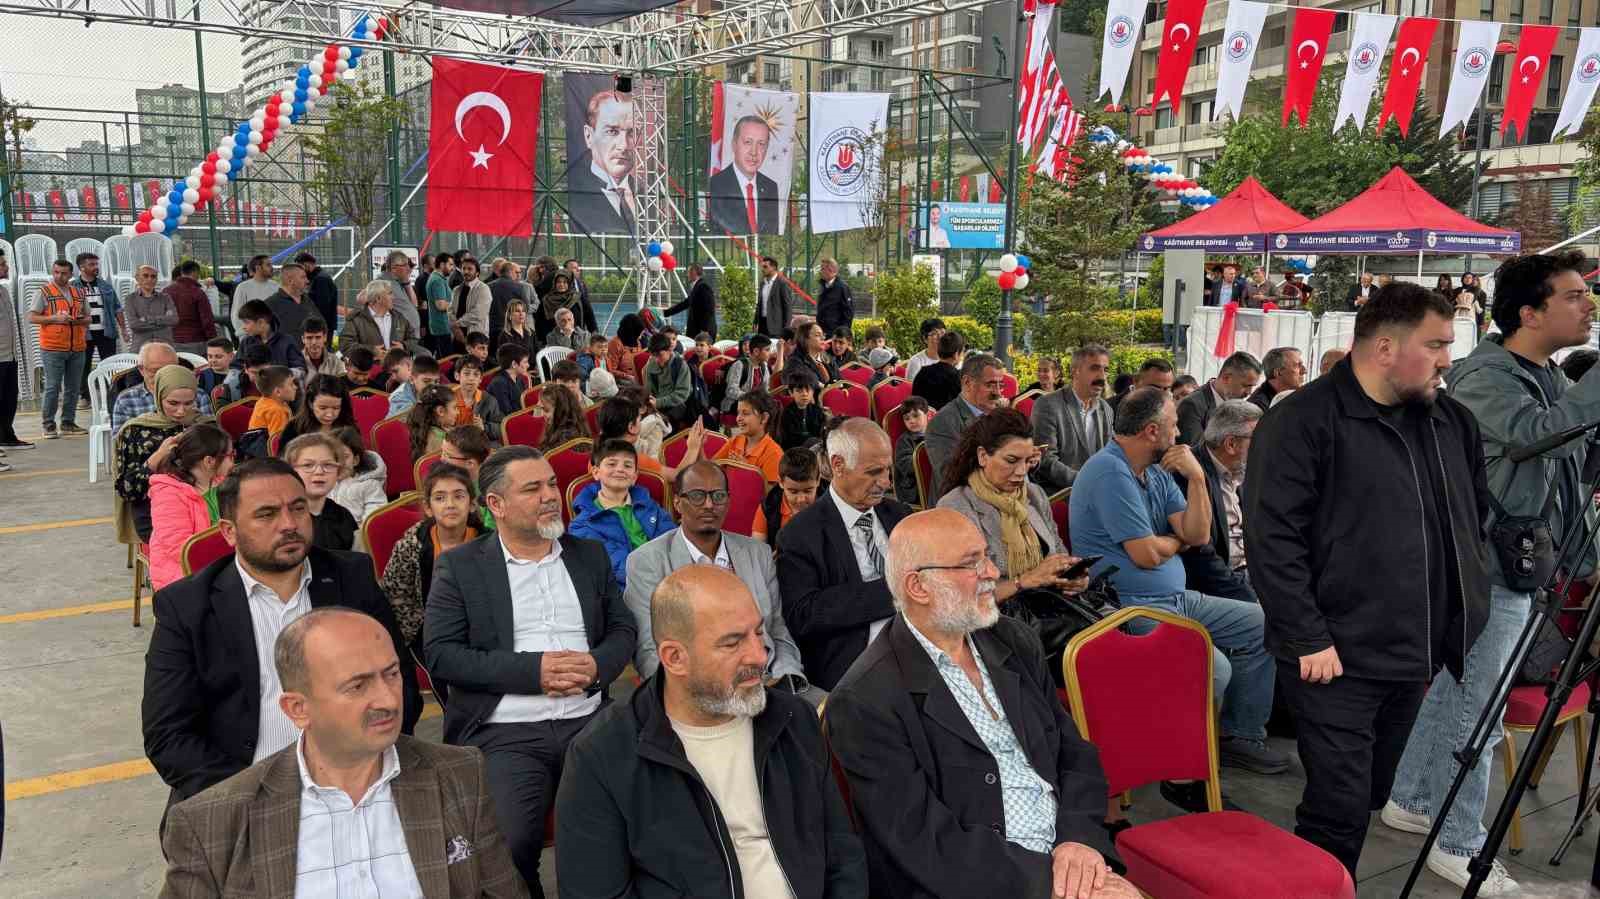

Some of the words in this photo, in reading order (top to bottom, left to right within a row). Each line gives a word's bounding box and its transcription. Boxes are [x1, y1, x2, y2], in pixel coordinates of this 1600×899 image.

[1163, 238, 1195, 246] KAĞITHANE
[1195, 238, 1228, 246] BELEDİYESİ
[1299, 236, 1336, 245] KAĞITHANE
[1337, 235, 1377, 244] BELEDİYESİ
